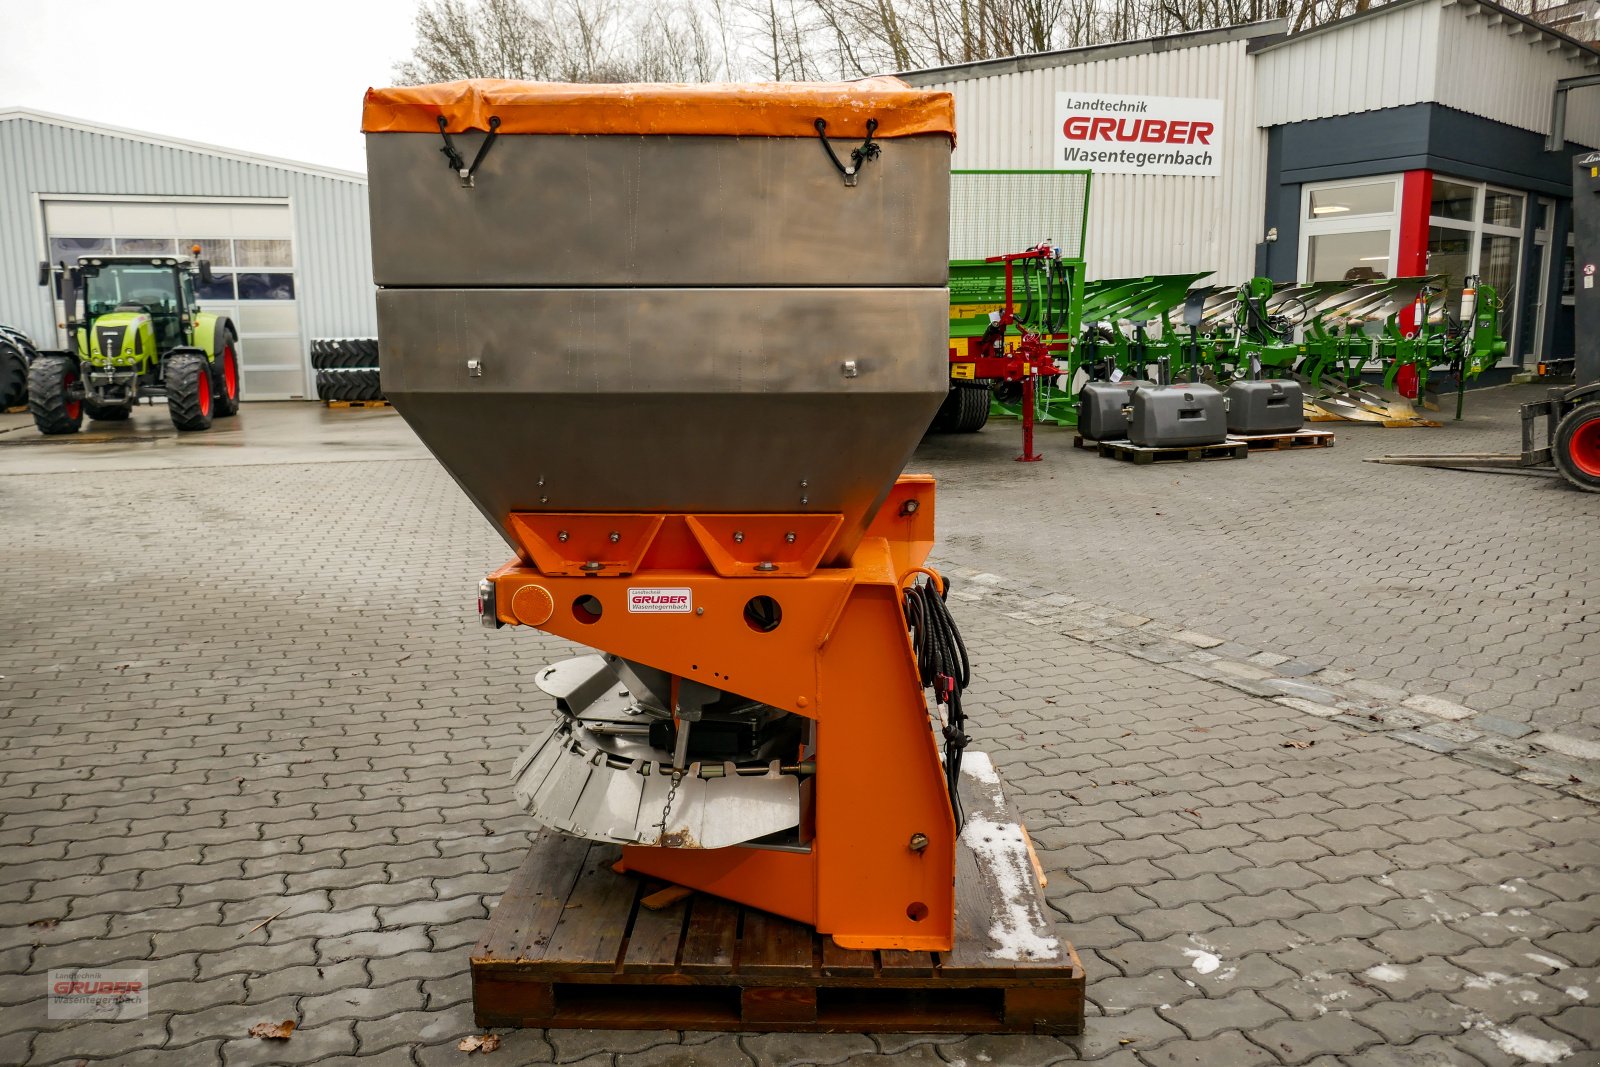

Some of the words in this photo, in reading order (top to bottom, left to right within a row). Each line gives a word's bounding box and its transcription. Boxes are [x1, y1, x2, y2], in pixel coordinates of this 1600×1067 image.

[1066, 98, 1148, 113] Landtechnik
[1063, 116, 1214, 145] GRUBER
[1064, 147, 1212, 167] Wasentegernbach
